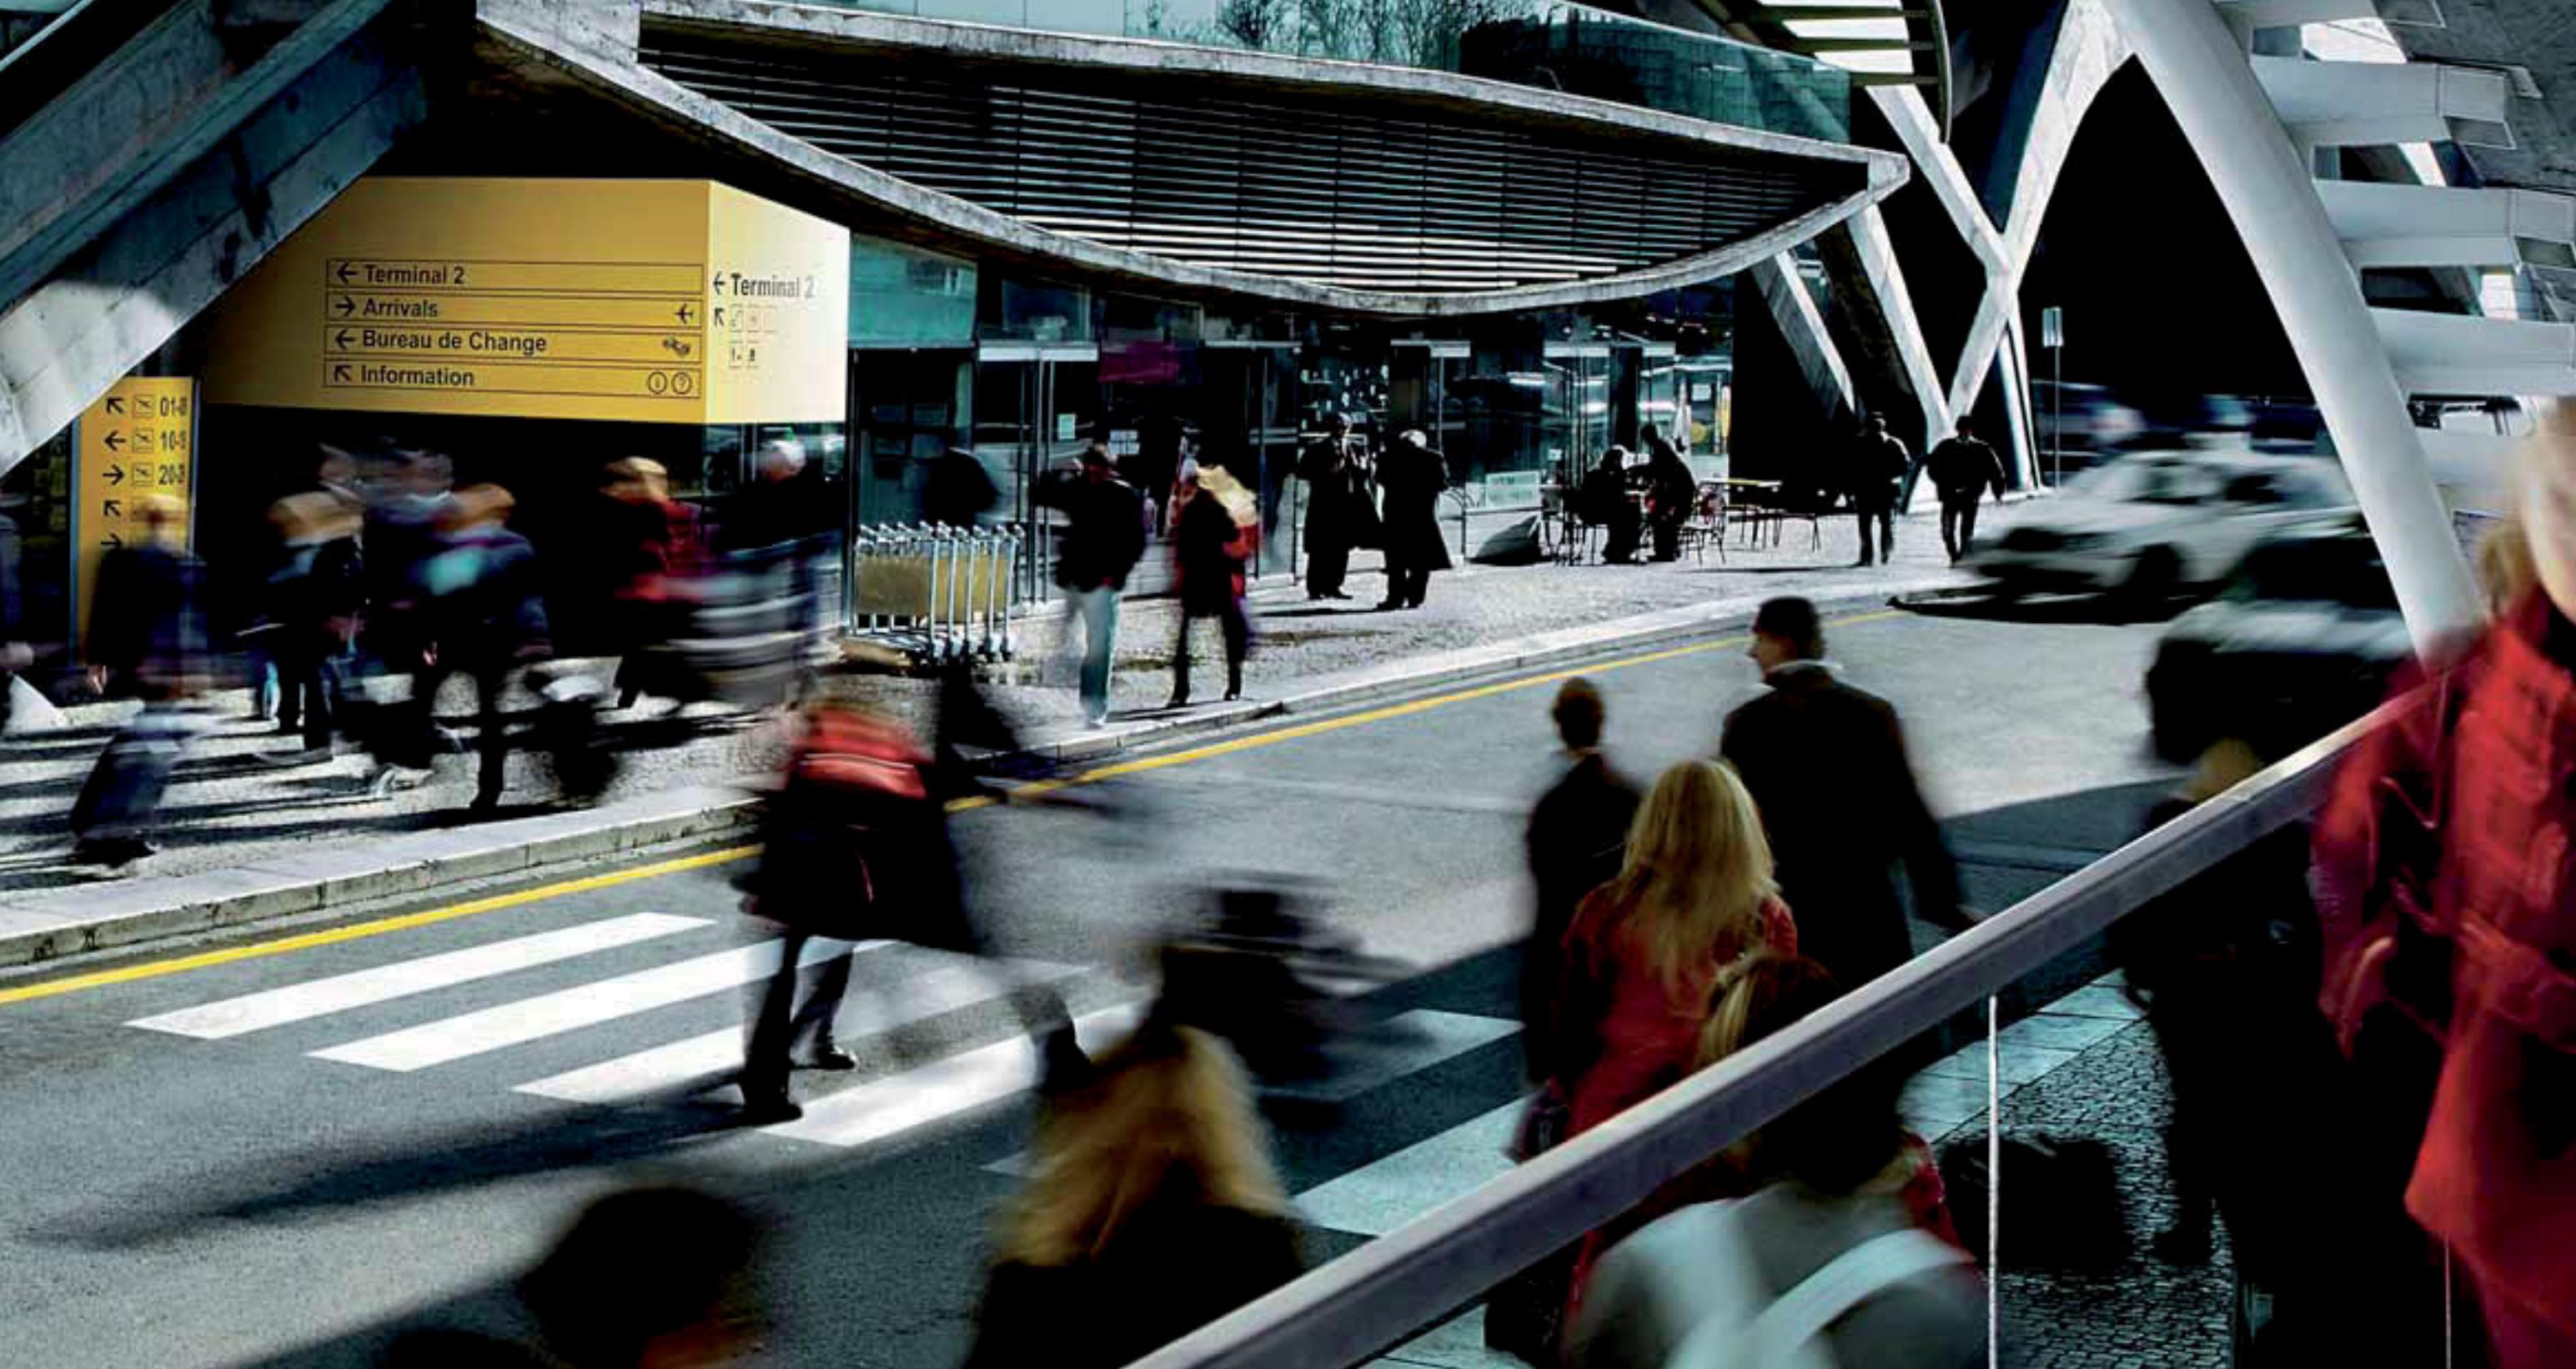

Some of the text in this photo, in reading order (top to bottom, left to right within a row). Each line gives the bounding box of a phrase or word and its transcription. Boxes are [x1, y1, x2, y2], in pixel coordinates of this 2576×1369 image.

[364, 263, 464, 284] Terminal 2
[731, 273, 816, 298] Terminal 2
[363, 298, 438, 318] Arrivals
[363, 329, 547, 356] Bureau de Change
[361, 365, 474, 386] Information
